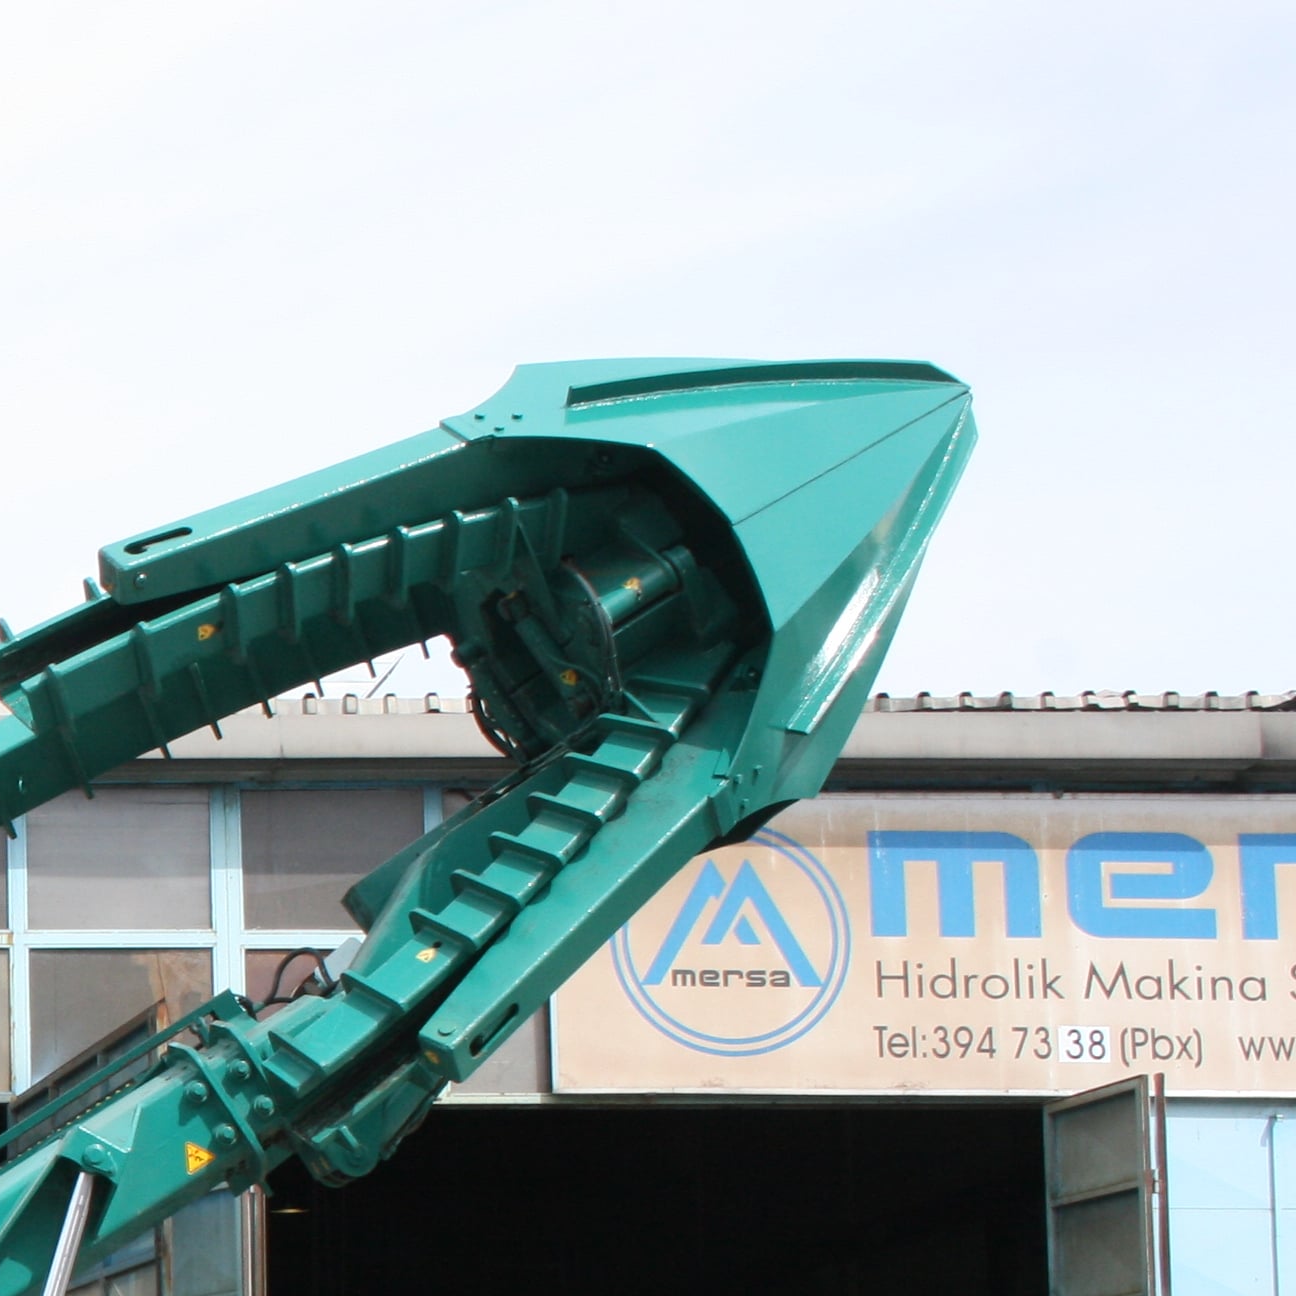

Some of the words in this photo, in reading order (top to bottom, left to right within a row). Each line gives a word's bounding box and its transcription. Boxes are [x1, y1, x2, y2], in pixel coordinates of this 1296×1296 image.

[671, 968, 791, 988] mersa
[875, 957, 1065, 999] Hidrolik
[1084, 958, 1267, 1001] Makina
[873, 1025, 997, 1060] Tel:394
[1011, 1026, 1053, 1060] 73
[1065, 1028, 1106, 1060] 38
[1119, 1027, 1204, 1068] (Pbx)
